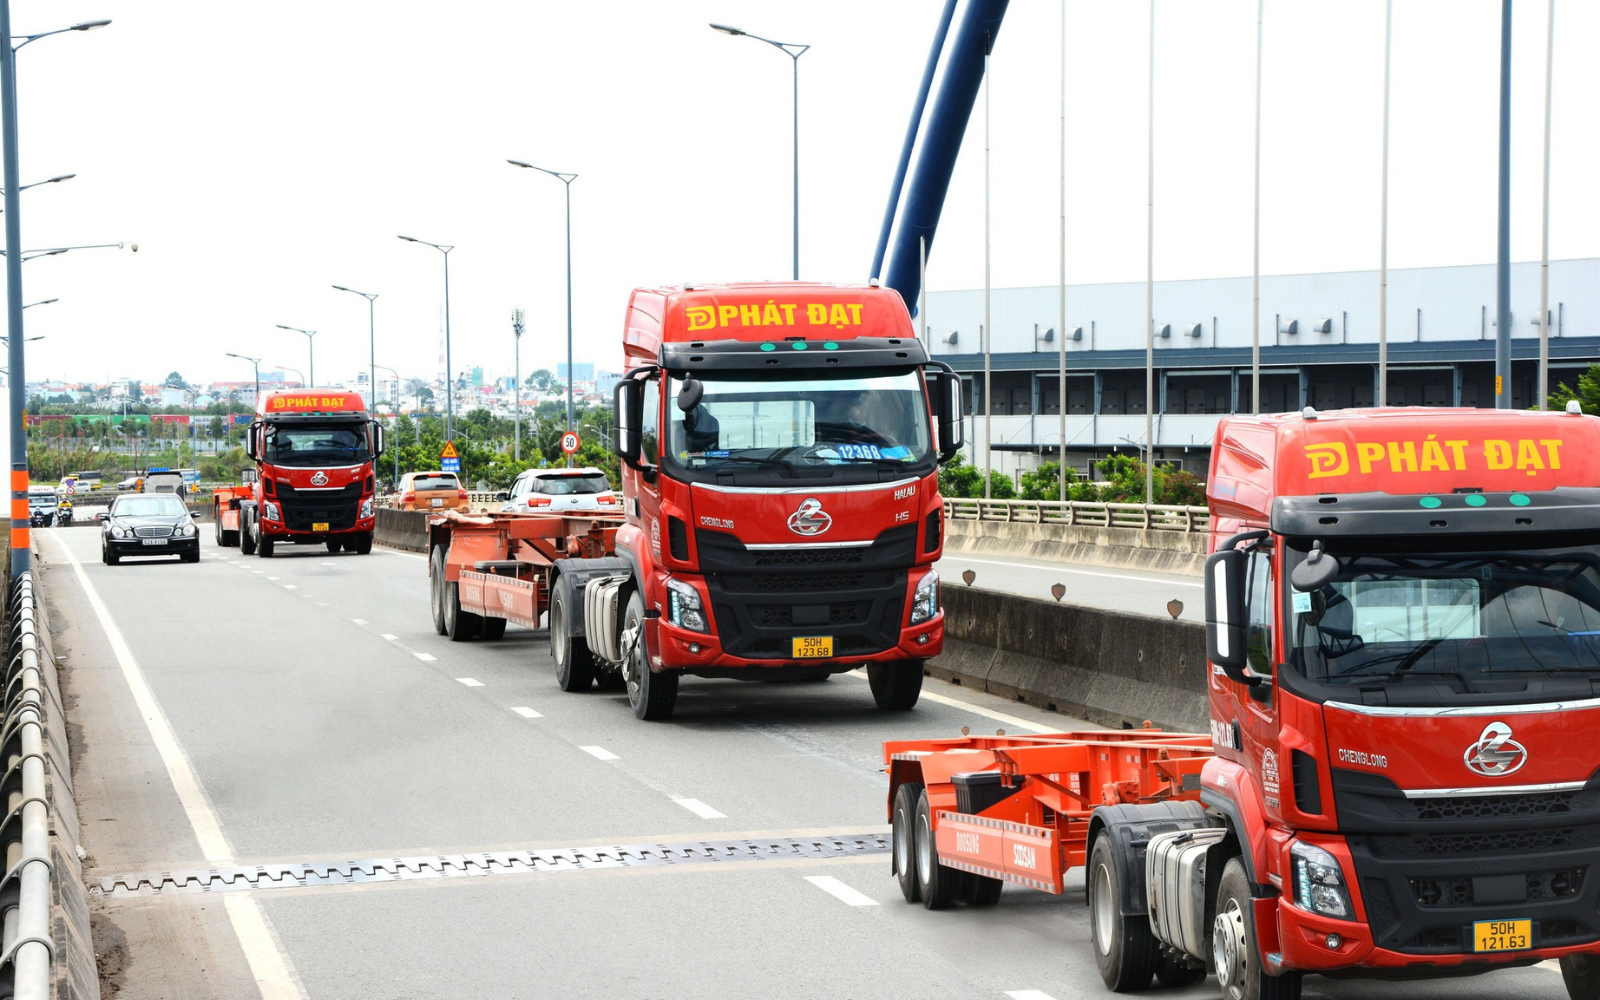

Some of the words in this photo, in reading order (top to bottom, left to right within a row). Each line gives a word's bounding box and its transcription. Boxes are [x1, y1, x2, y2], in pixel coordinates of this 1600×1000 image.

[718, 300, 797, 327] PHÁT
[806, 303, 864, 329] ĐẠT
[287, 396, 318, 408] PHÁT
[322, 397, 345, 408] ĐẠT
[565, 437, 575, 448] 50
[838, 444, 881, 460] 12368
[1356, 434, 1469, 474] PHÁT
[1483, 439, 1563, 476] ĐẠT
[699, 515, 735, 530] CHENGLONG
[804, 638, 822, 647] 50H
[798, 647, 829, 657] 123.68
[1338, 748, 1388, 769] CHENGLONG
[1490, 921, 1516, 935] 50H
[1481, 935, 1526, 950] 121.63
